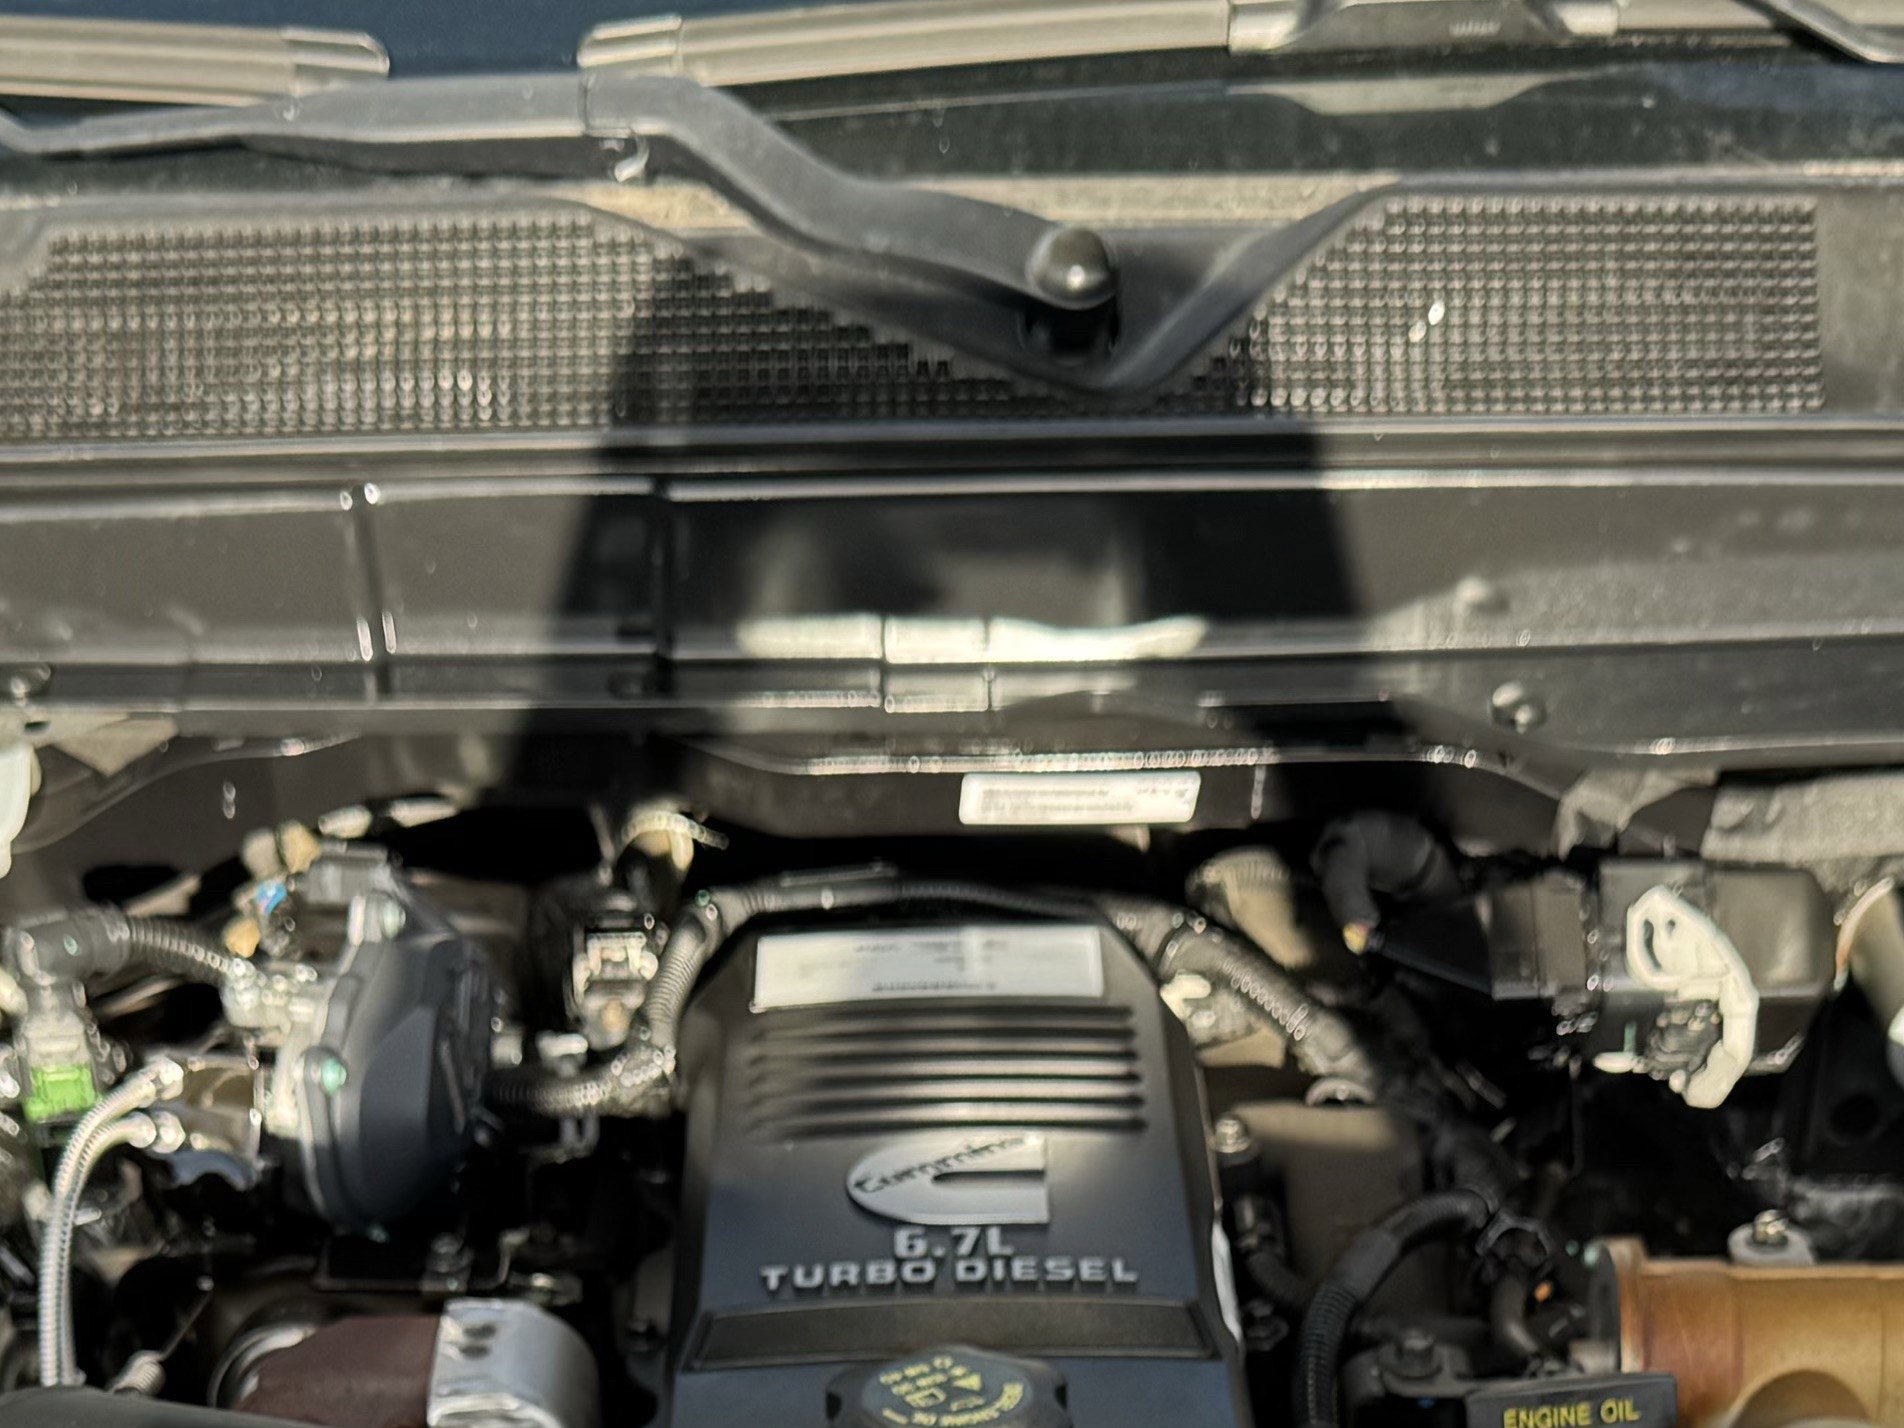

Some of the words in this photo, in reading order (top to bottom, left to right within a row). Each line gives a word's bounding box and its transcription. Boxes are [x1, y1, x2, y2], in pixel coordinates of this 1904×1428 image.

[896, 1227, 1014, 1258] 6.7L
[759, 1259, 937, 1291] TURBO
[954, 1255, 1139, 1285] DIESEL
[1600, 1398, 1642, 1424] OIL
